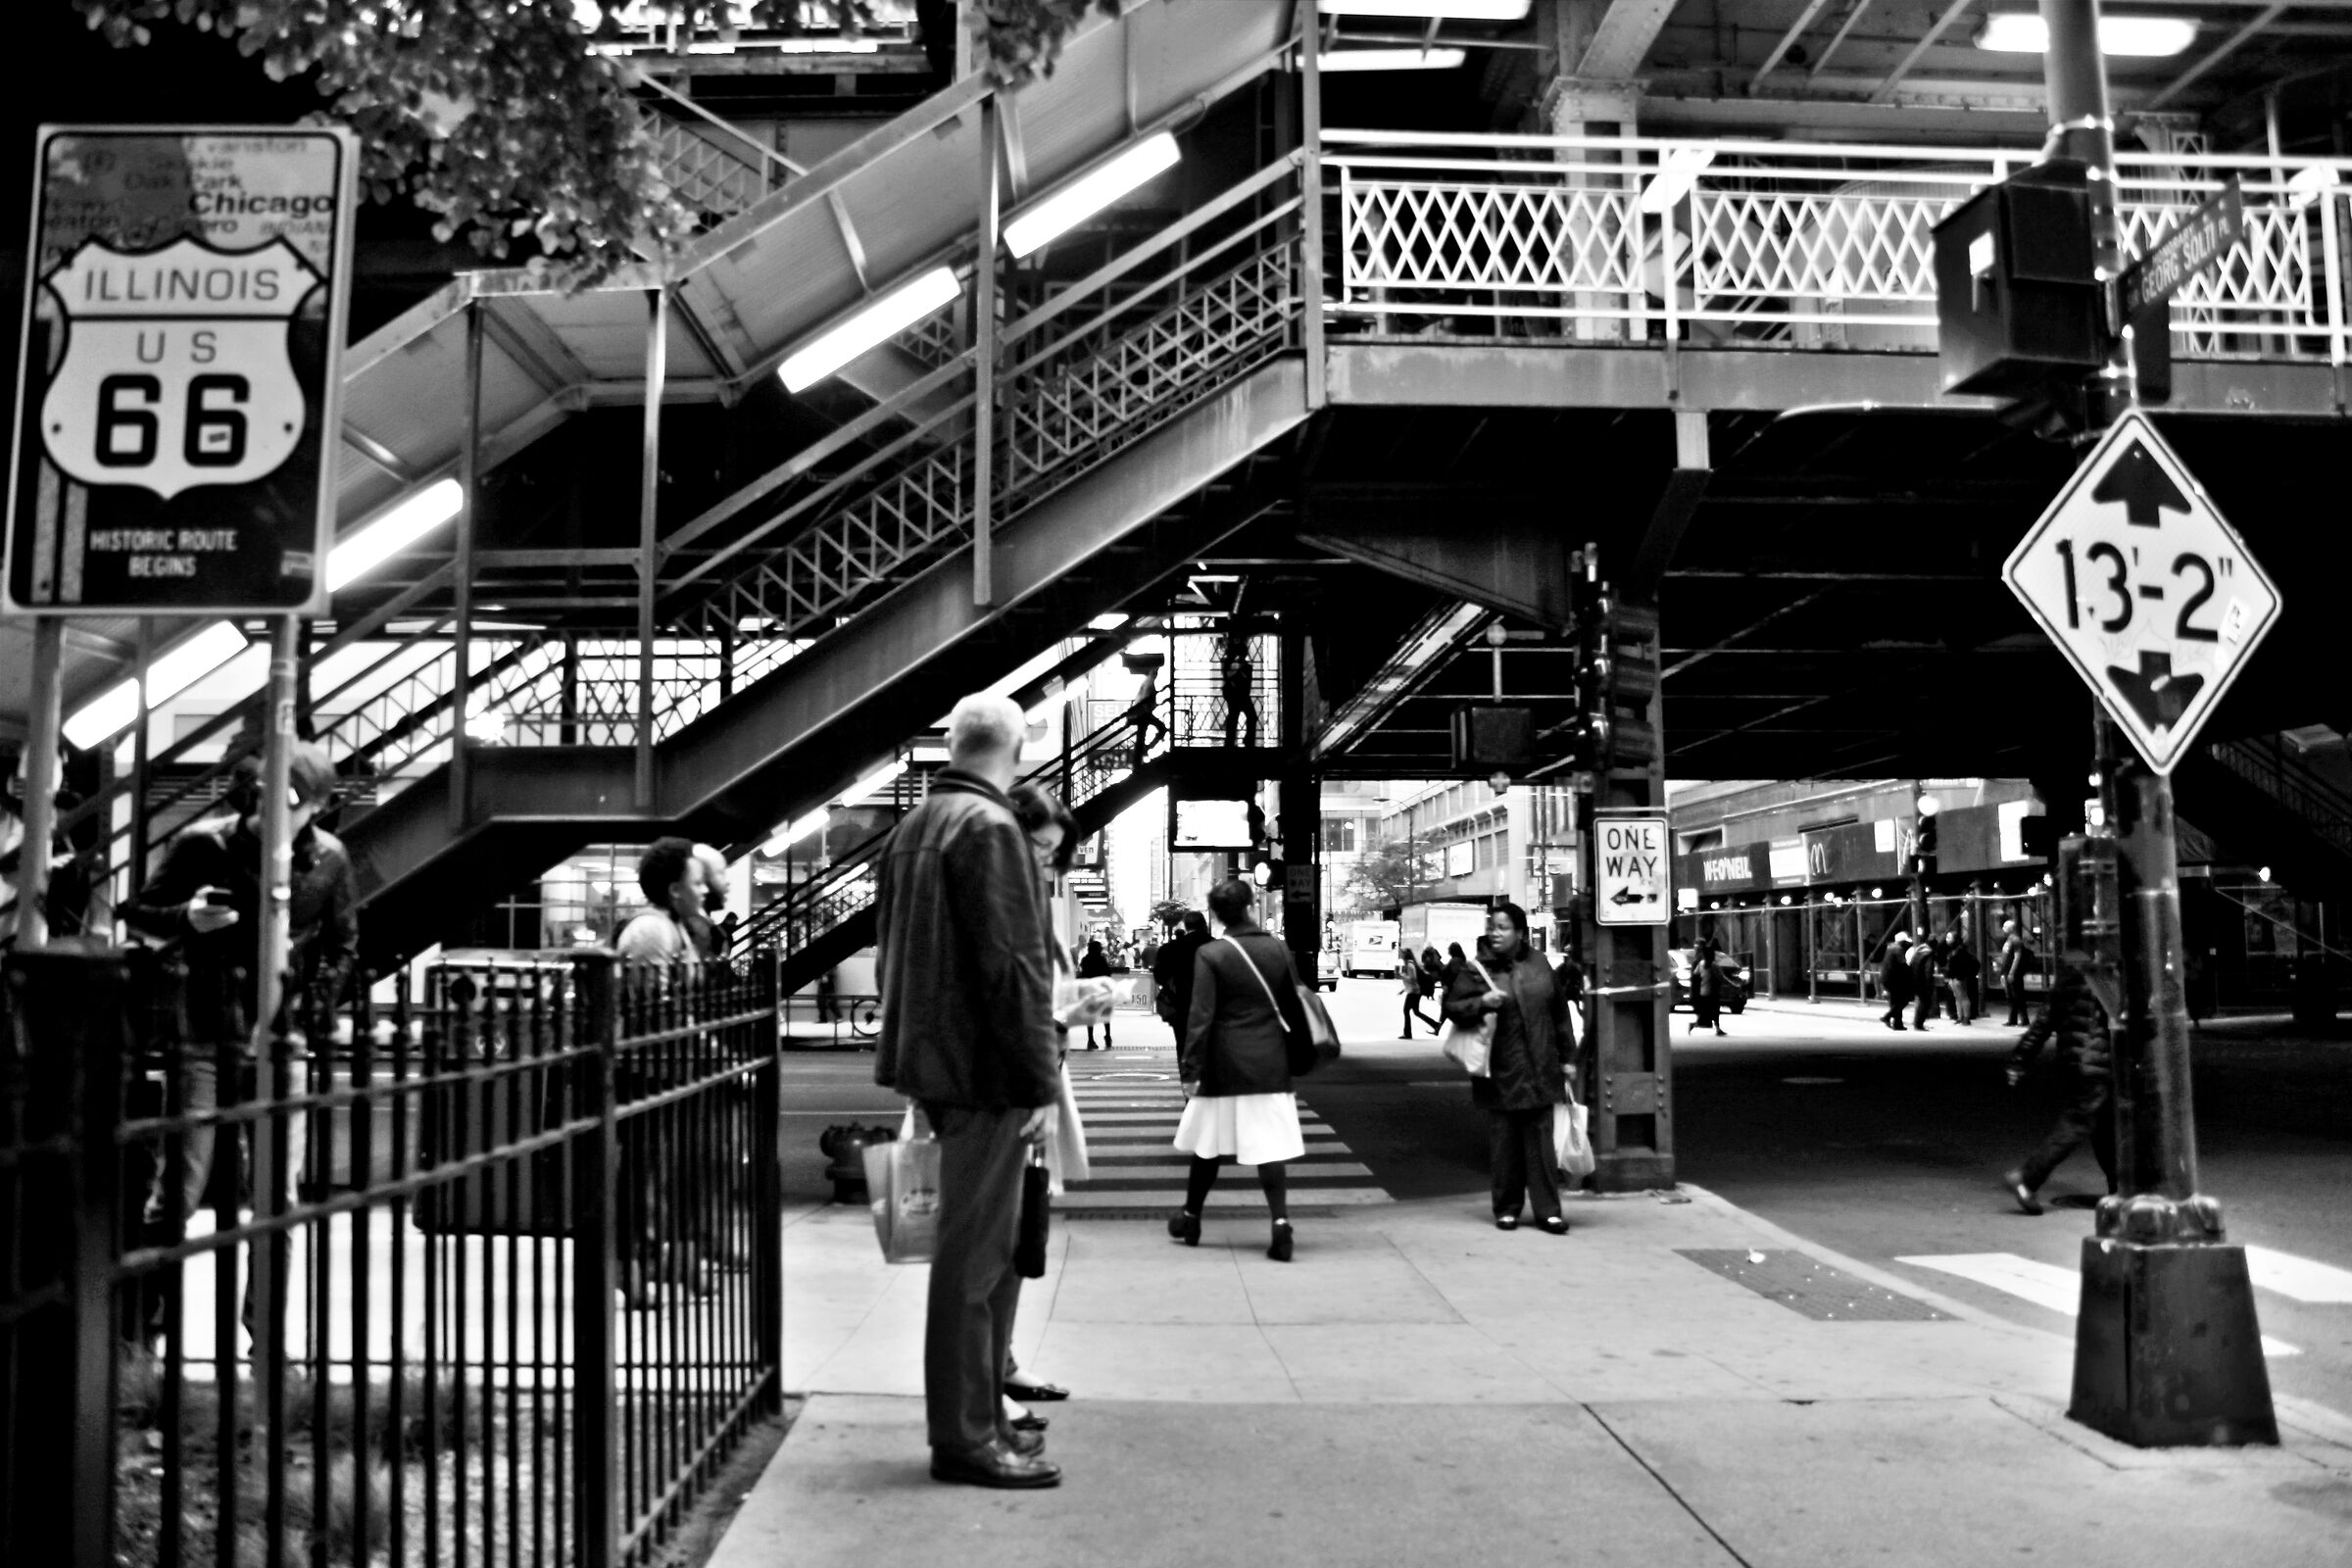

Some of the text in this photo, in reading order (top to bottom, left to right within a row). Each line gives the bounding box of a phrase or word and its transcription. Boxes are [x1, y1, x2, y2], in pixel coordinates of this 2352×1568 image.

[189, 191, 335, 219] Chicago
[2141, 253, 2179, 305] GEORG
[2182, 221, 2216, 271] SOLTI
[85, 269, 280, 302] ILLINOIS
[94, 372, 251, 468] 66
[89, 529, 238, 552] HISTORIC ROUTE
[128, 555, 196, 577] BEGINS
[1607, 827, 1656, 851] ONE
[1606, 856, 1658, 878] WAY
